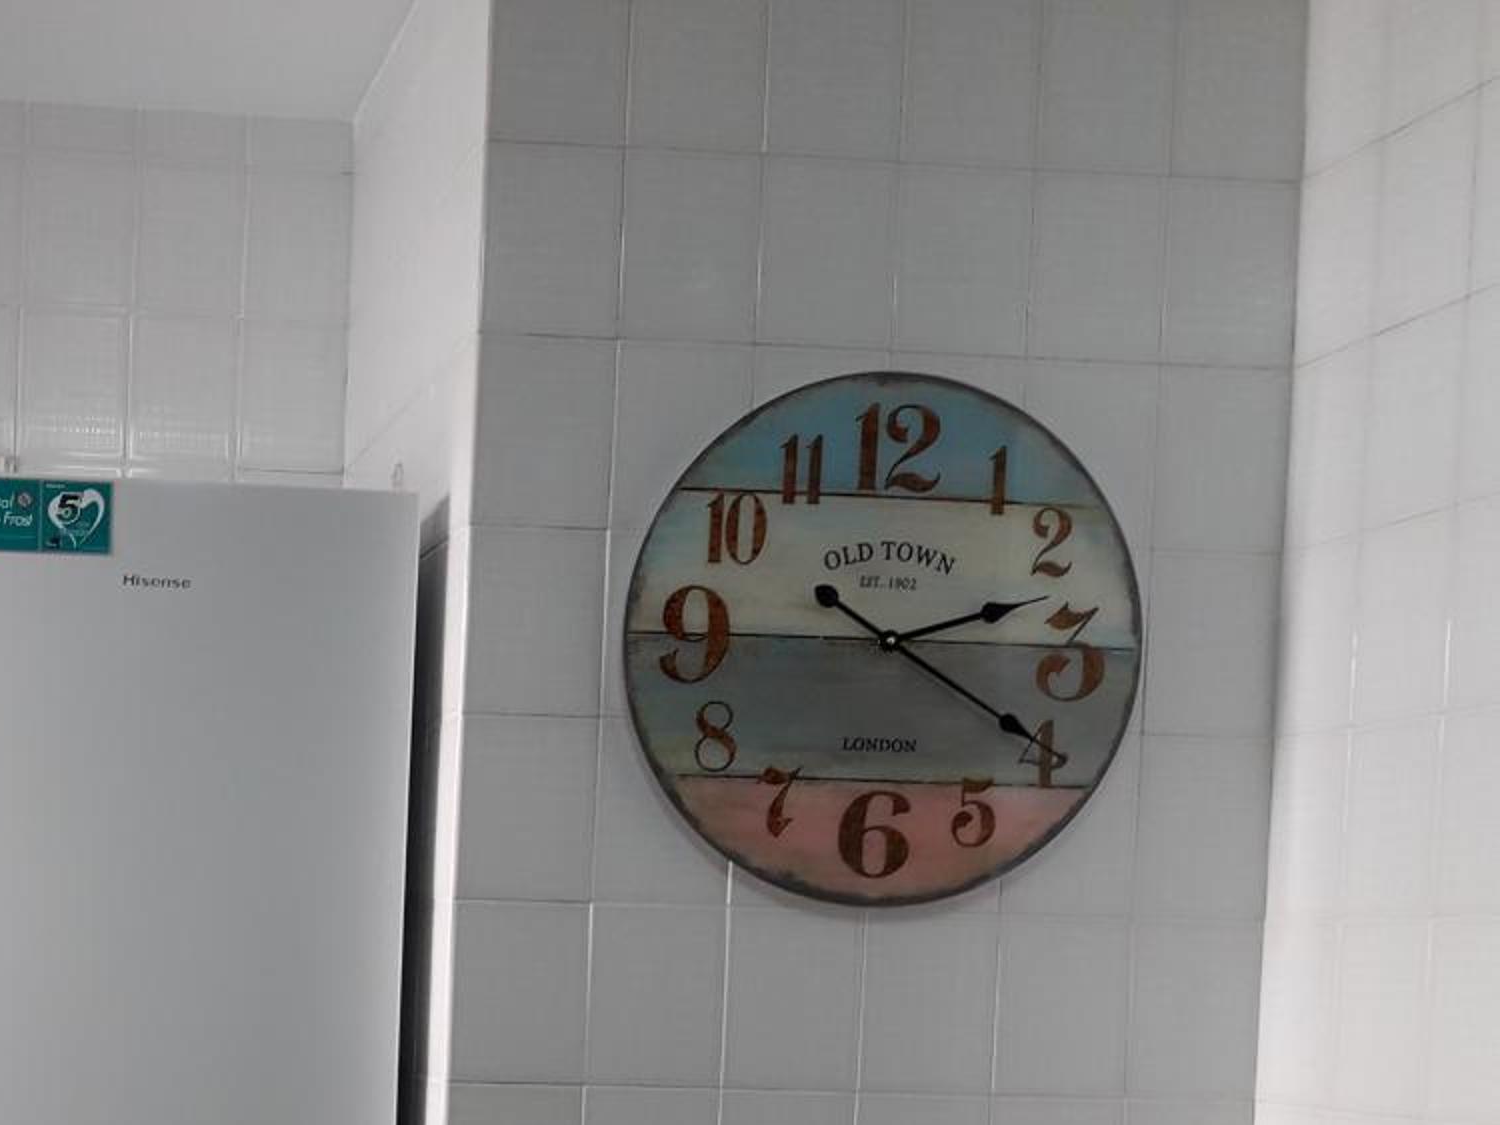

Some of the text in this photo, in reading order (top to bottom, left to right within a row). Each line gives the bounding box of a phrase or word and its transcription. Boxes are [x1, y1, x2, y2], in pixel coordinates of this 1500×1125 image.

[779, 433, 824, 506] 11
[854, 401, 941, 494] 12
[988, 444, 1009, 516] 1
[4, 512, 34, 528] Frost
[706, 491, 768, 565] 10
[1030, 506, 1073, 577] 2
[122, 573, 192, 590] Hisense
[823, 540, 957, 576] OLD TOWN
[659, 585, 731, 684] 9
[1035, 601, 1105, 702] 3
[694, 700, 737, 772] 8
[842, 736, 917, 754] LONDON
[1019, 719, 1067, 789] 4
[757, 765, 802, 839] 7
[837, 790, 911, 879] 6
[950, 776, 997, 848] 5
